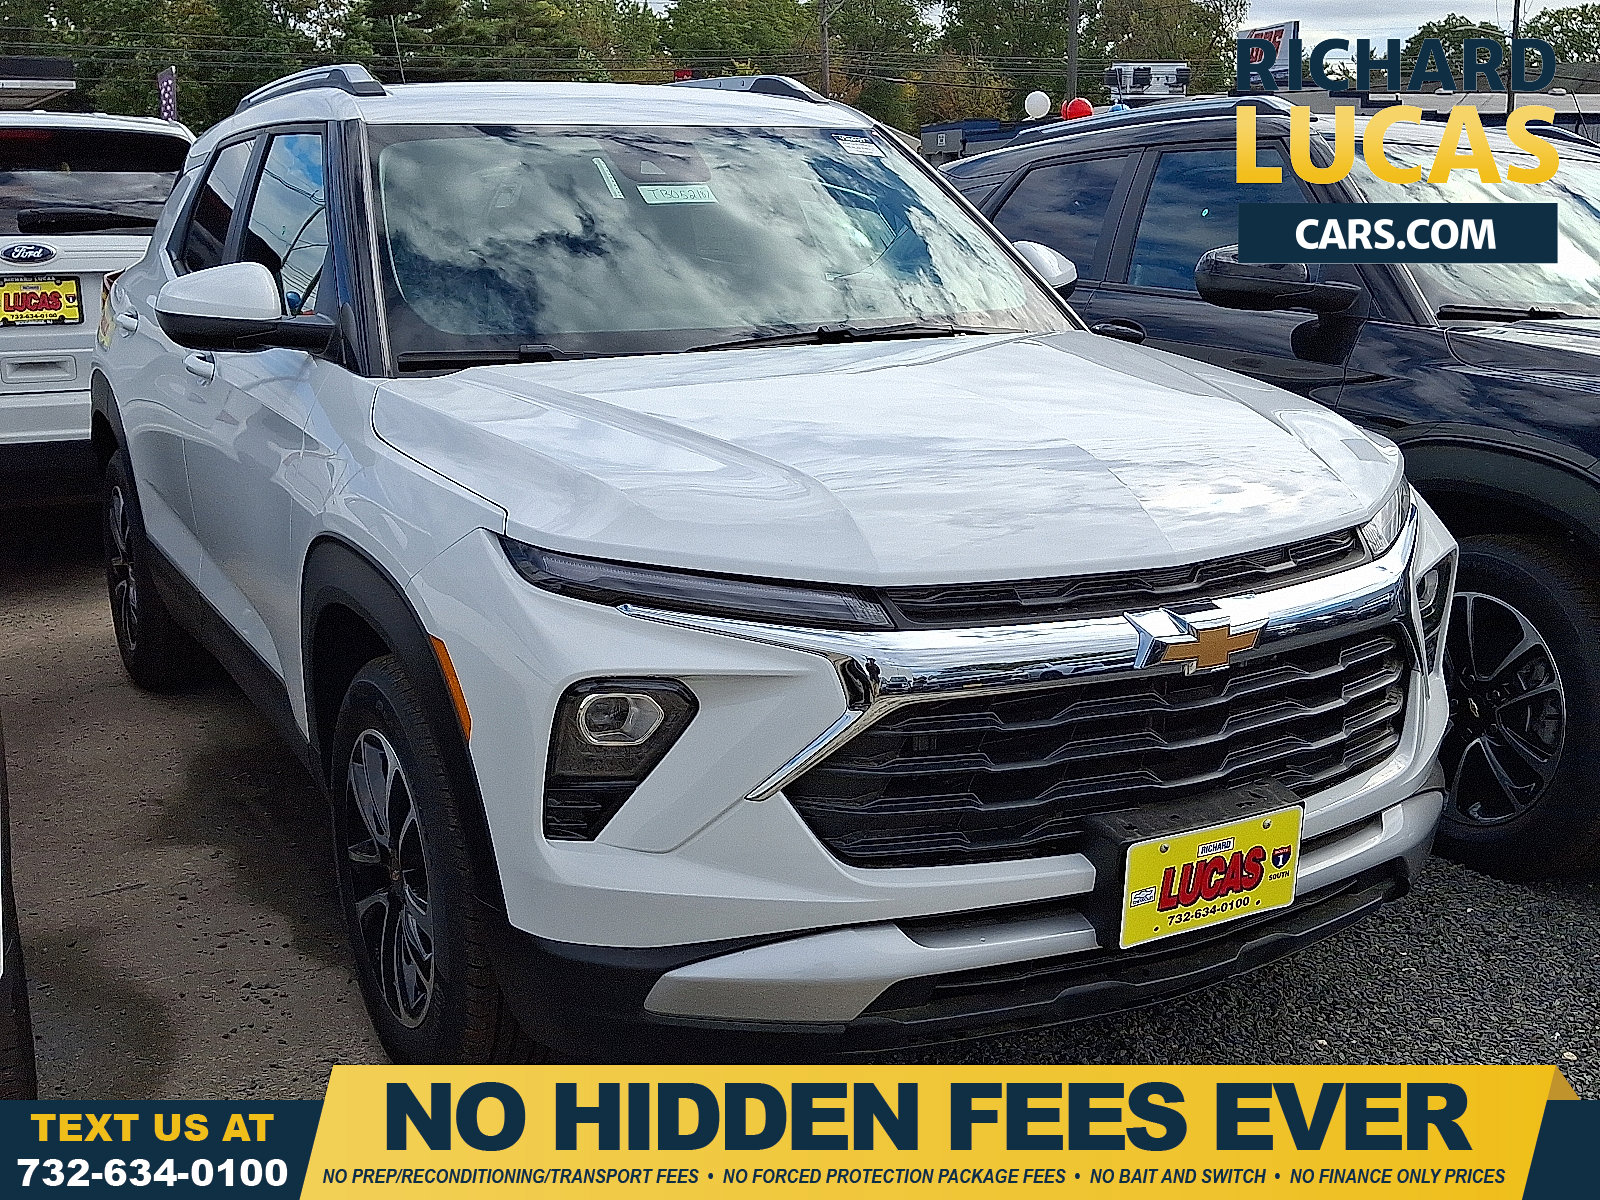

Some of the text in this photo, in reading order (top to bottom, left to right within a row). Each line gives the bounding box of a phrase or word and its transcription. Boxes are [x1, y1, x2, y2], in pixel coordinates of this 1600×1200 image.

[11, 246, 43, 258] Ford
[4, 291, 62, 312] LUCAS
[1200, 840, 1232, 855] RICHARD
[1276, 854, 1284, 867] 1
[1157, 846, 1267, 912] LUCAS
[1268, 870, 1290, 881] SOUTH
[1167, 896, 1250, 926] 732-634-0100
